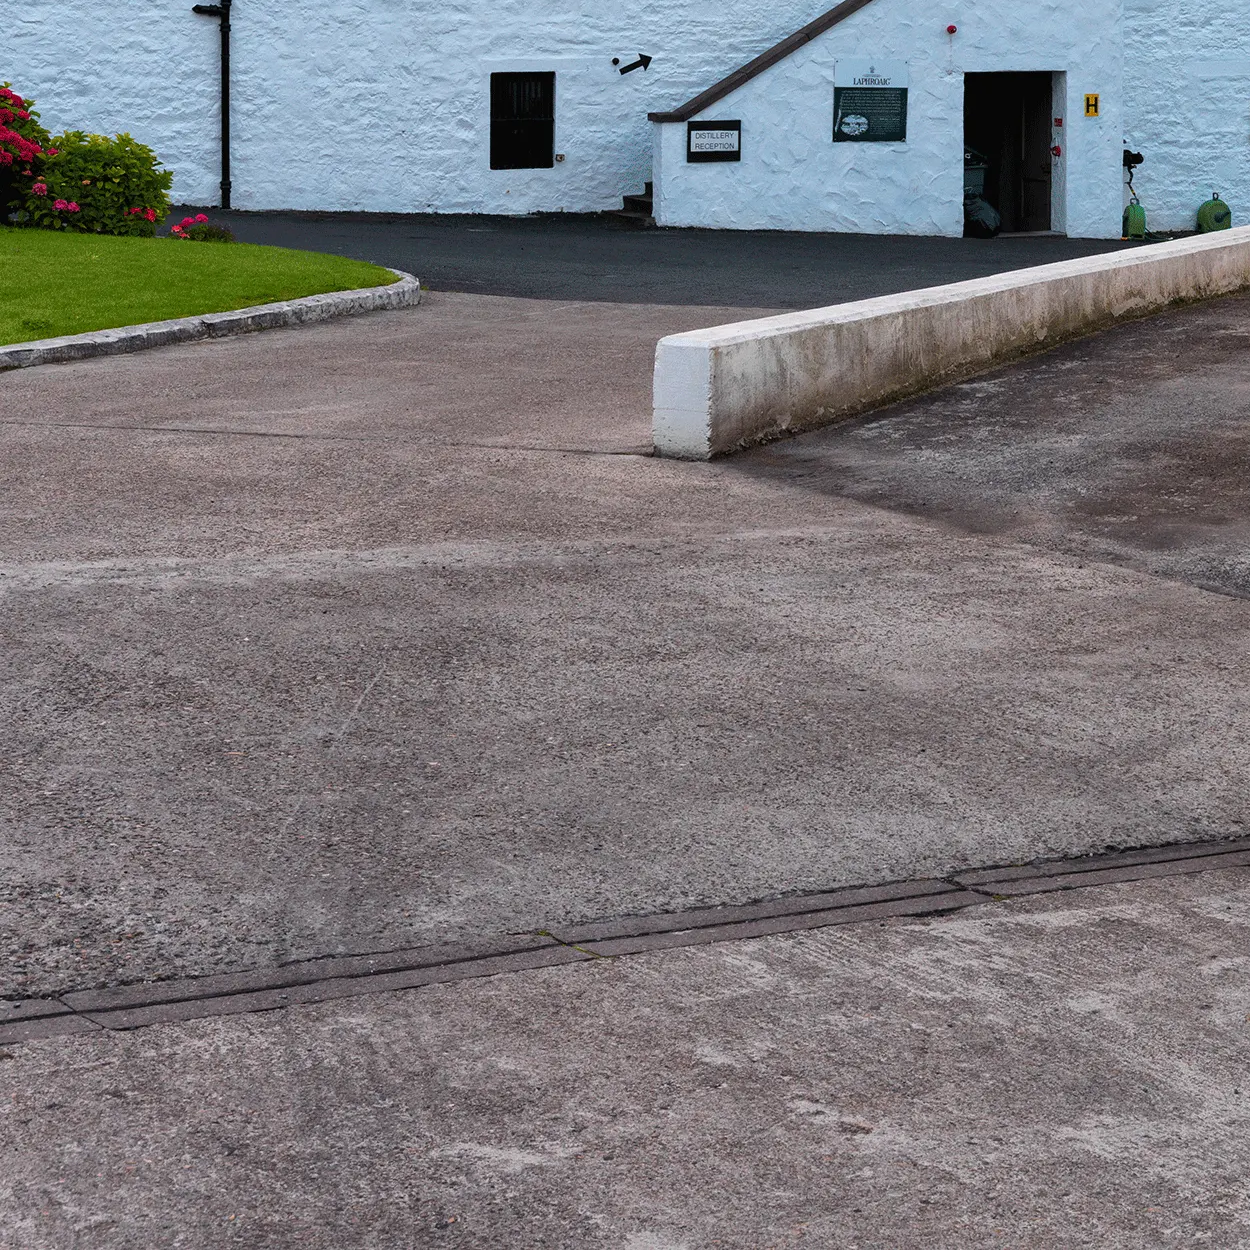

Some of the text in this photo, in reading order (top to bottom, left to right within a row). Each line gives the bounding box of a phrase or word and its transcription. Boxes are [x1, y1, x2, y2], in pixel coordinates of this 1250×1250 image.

[853, 77, 891, 86] LAPHROAIG
[1086, 96, 1098, 114] H
[695, 131, 735, 140] DISTILLERY
[694, 142, 735, 150] RECEPTION
